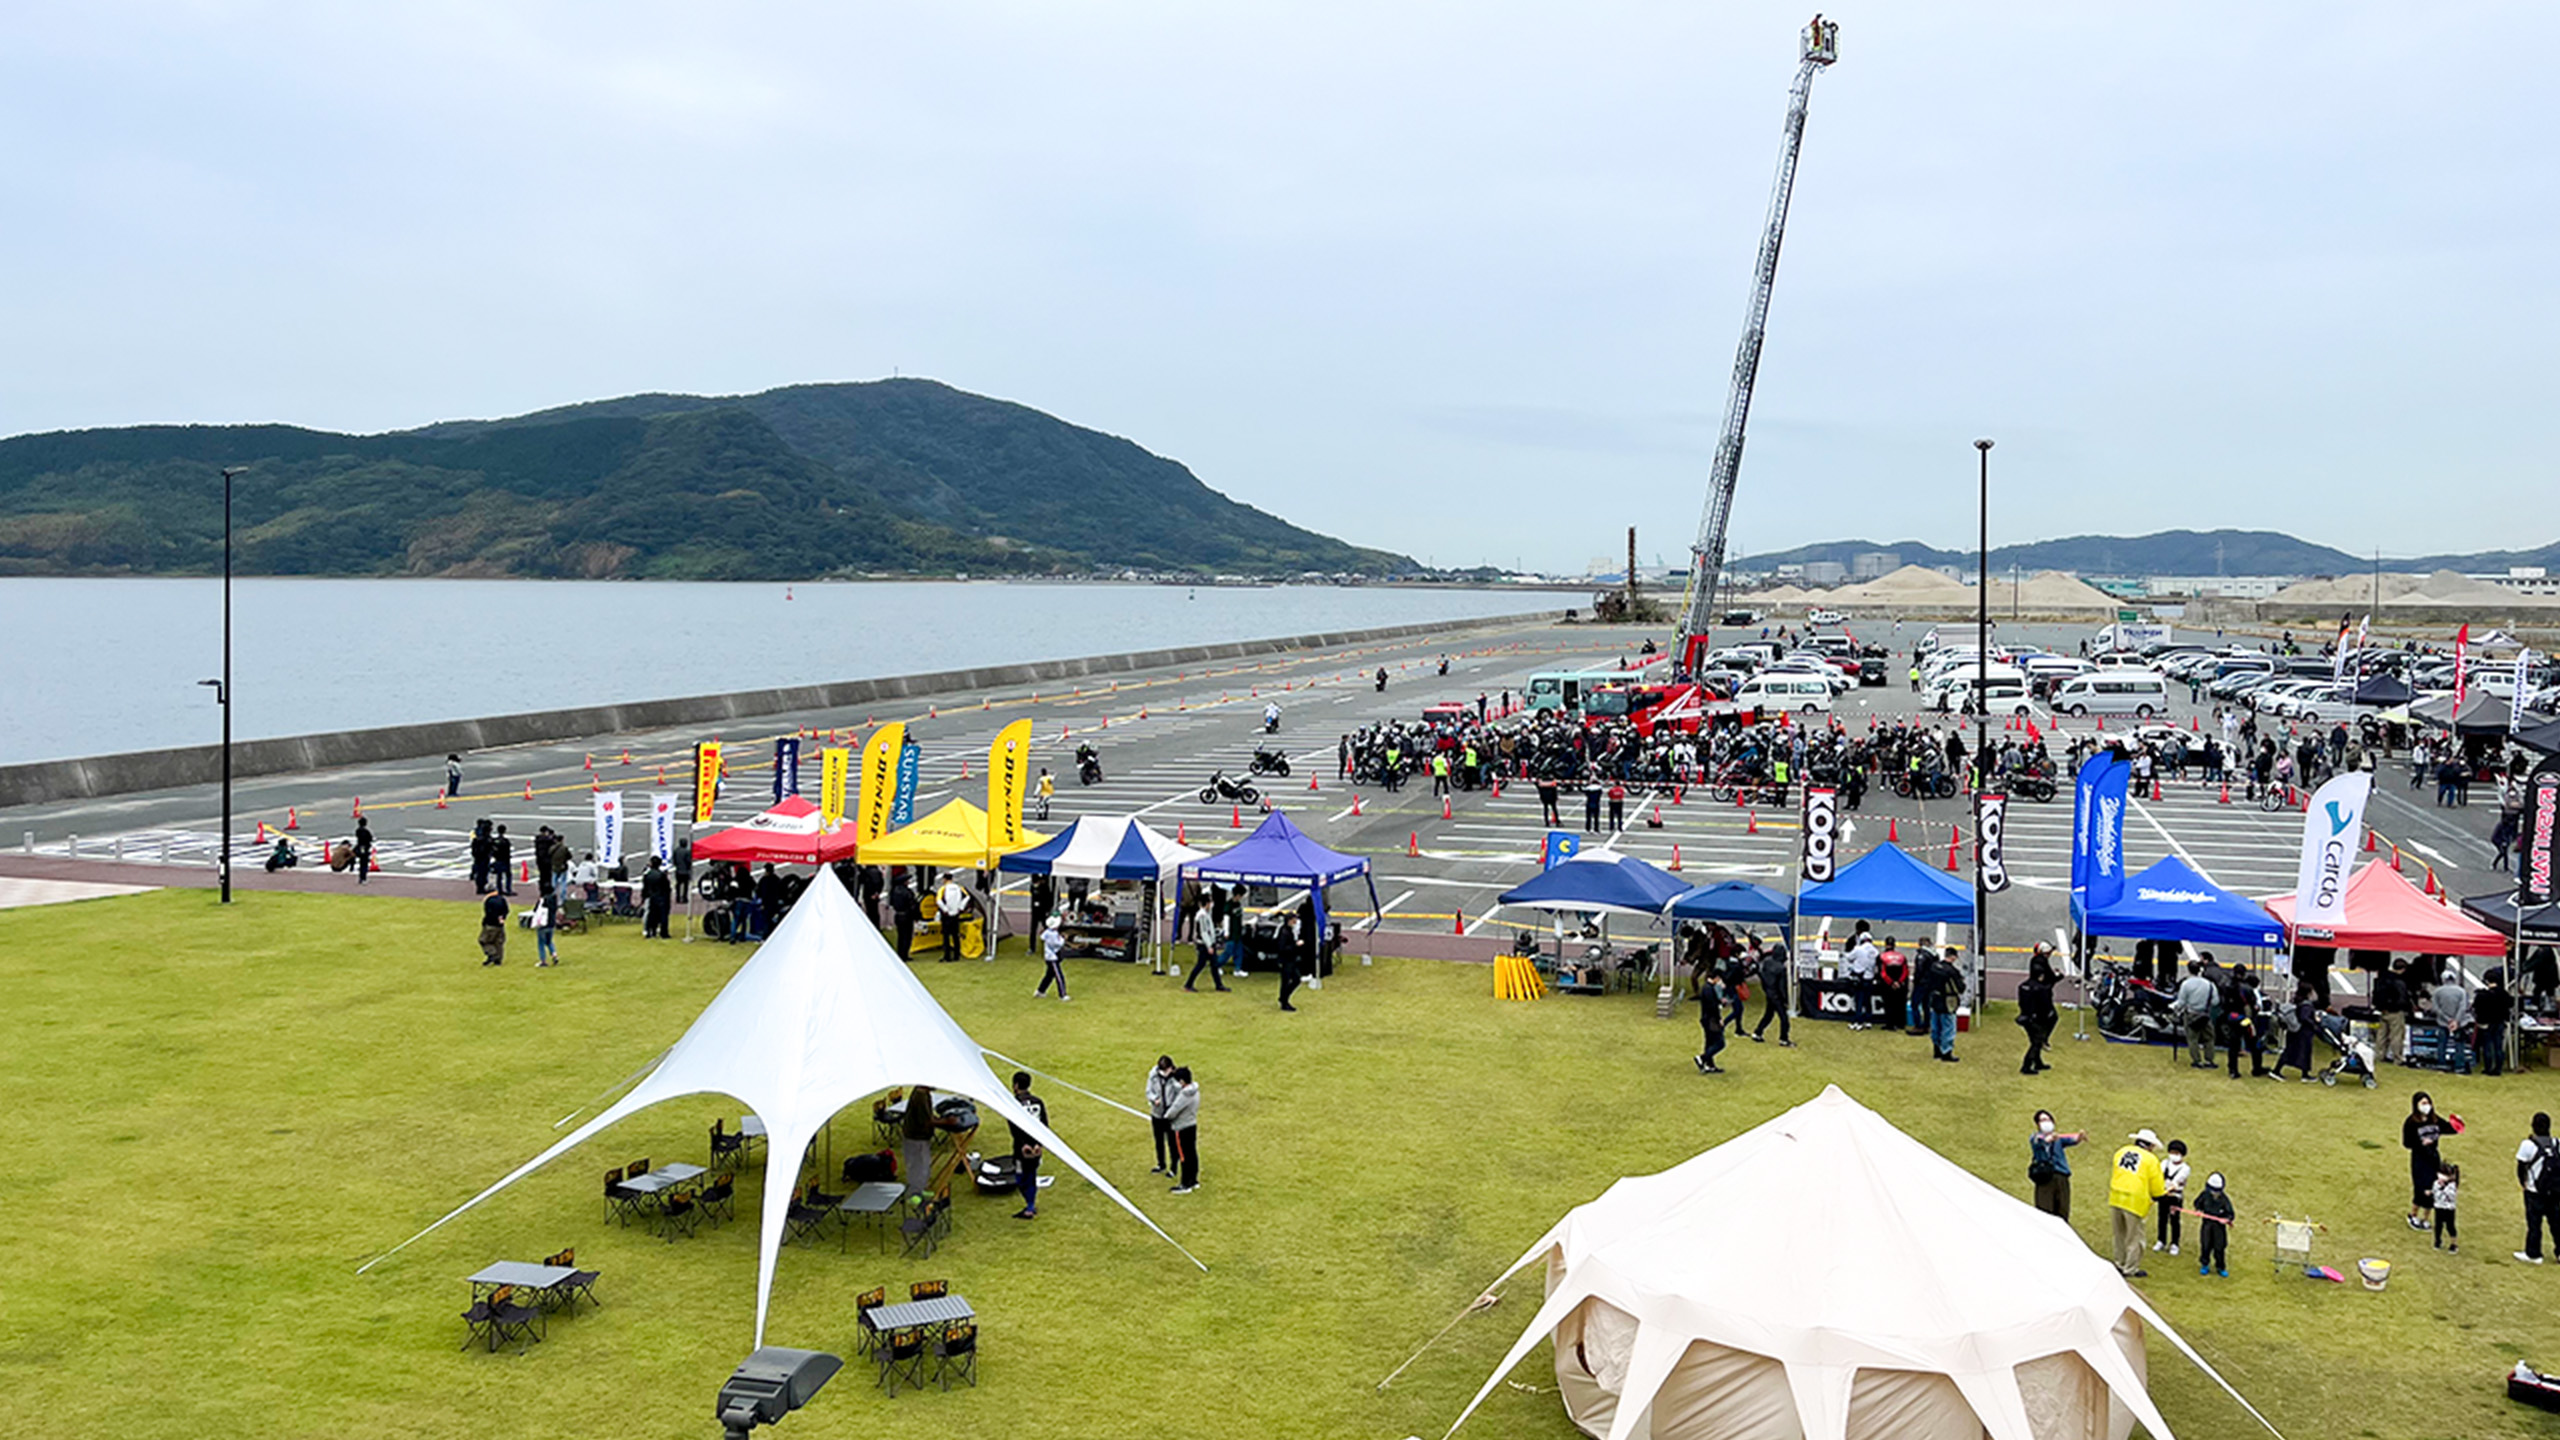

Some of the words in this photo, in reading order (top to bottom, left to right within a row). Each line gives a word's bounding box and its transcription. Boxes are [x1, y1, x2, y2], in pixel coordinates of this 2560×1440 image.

[700, 749, 717, 817] PIRELLI
[870, 757, 888, 840] DUNLOP
[894, 748, 916, 821] SUNSTAR
[1004, 756, 1015, 842] DUNLOP
[604, 814, 614, 863] SUZUKI
[657, 816, 668, 866] SUZUKI
[1805, 788, 1835, 881] KOOD
[1980, 794, 2006, 891] KOOD
[2530, 787, 2557, 894] KUSHITANI
[1818, 991, 1885, 1015] KOD
